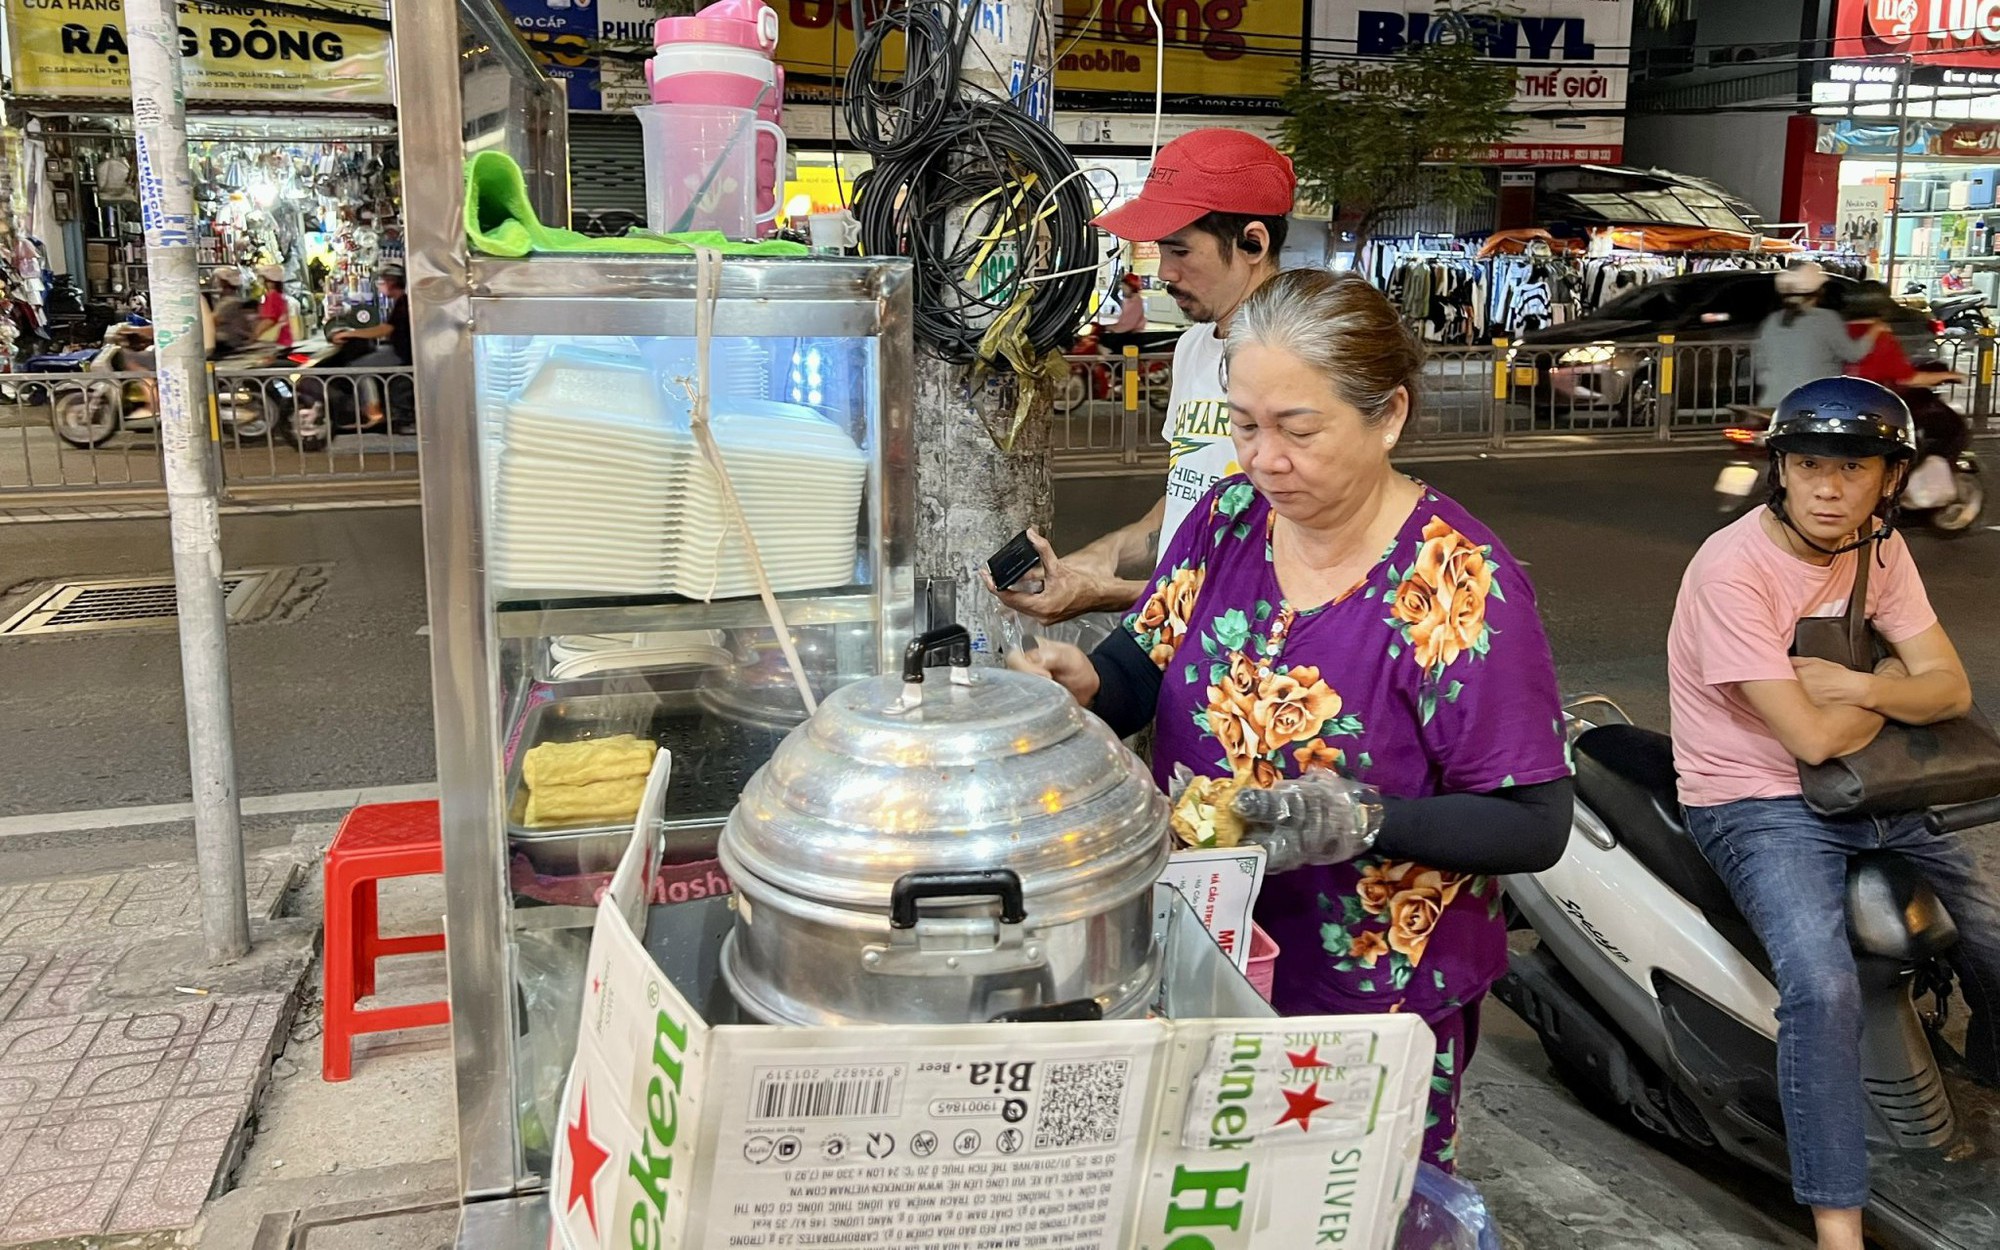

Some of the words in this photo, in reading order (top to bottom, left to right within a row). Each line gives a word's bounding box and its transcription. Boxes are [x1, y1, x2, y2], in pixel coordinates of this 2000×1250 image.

[536, 15, 566, 28] CẤP
[61, 22, 198, 64] RẠG
[209, 18, 344, 62] ĐÔNG
[1058, 50, 1141, 73] mobile
[1525, 68, 1561, 97] THẾ
[1563, 69, 1608, 99] GIỚI
[1283, 1031, 1343, 1047] SILVER
[916, 1062, 952, 1073] Beer
[968, 1062, 1035, 1094] Bia
[1278, 1065, 1346, 1085] SILVER
[1315, 1149, 1362, 1246] SILVER
